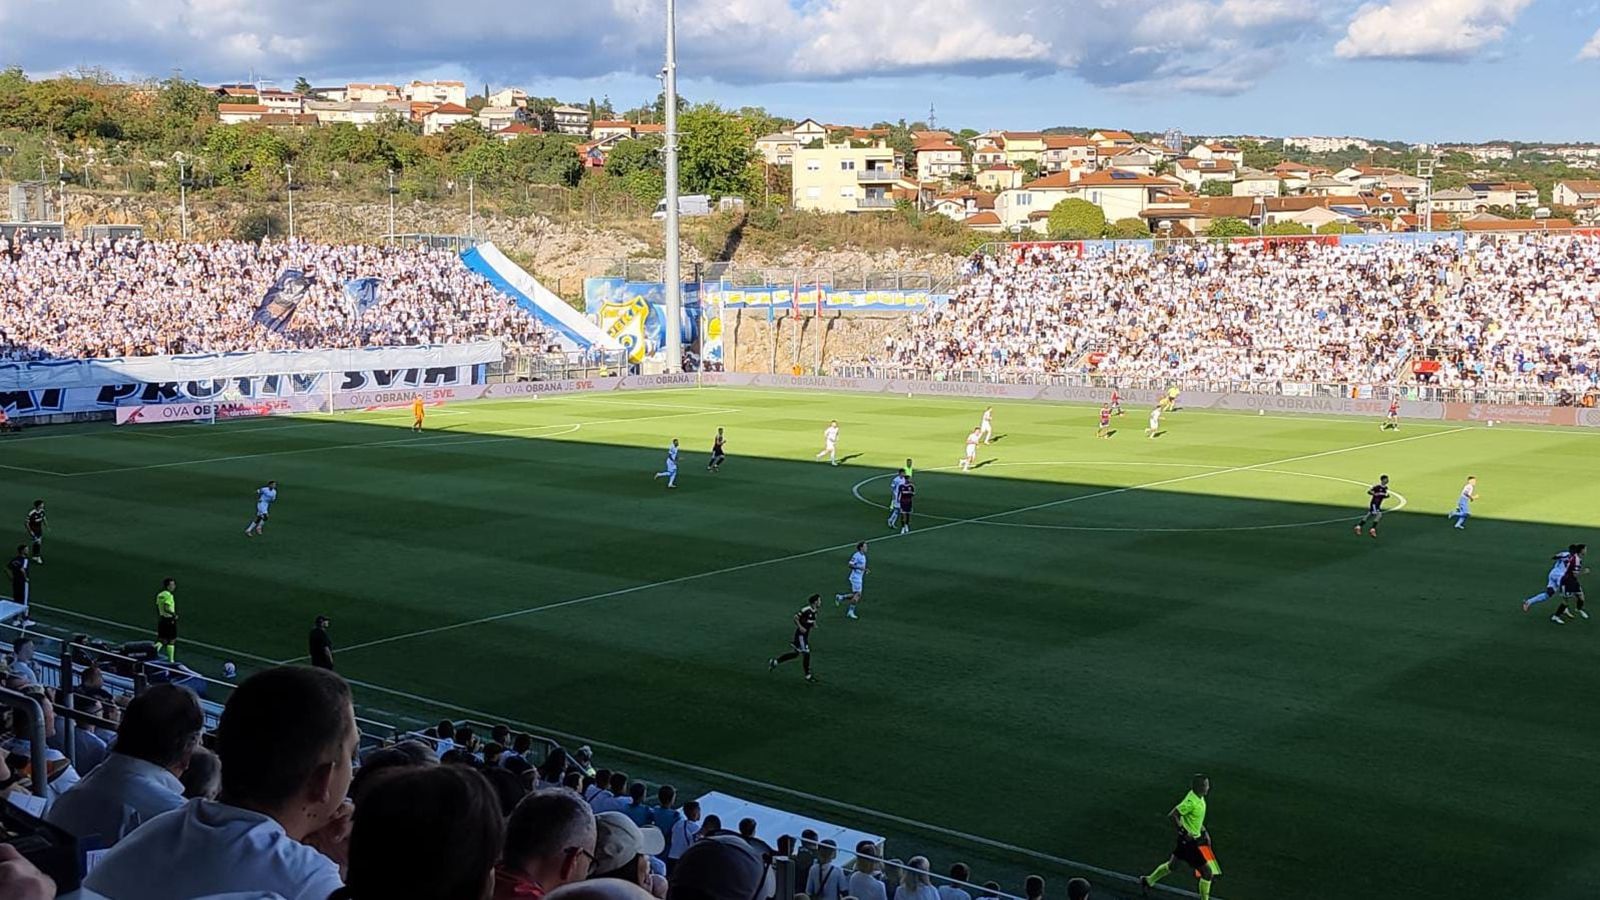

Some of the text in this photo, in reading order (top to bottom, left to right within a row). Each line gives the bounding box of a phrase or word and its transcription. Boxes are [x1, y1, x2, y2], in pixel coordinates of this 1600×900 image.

[655, 375, 690, 384] OBRANA
[791, 377, 826, 387] OBRANA
[505, 380, 594, 394] OVA OBRANA JE SVE.
[930, 382, 969, 393] OBRANA
[350, 394, 371, 405] OVA
[375, 391, 417, 403] OBRANA
[433, 388, 455, 399] SVE.
[1063, 388, 1086, 398] OVA
[1246, 397, 1271, 408] OVA
[1276, 398, 1333, 411] OBRANA
[1338, 400, 1353, 412] JE
[163, 406, 190, 418] OVA
